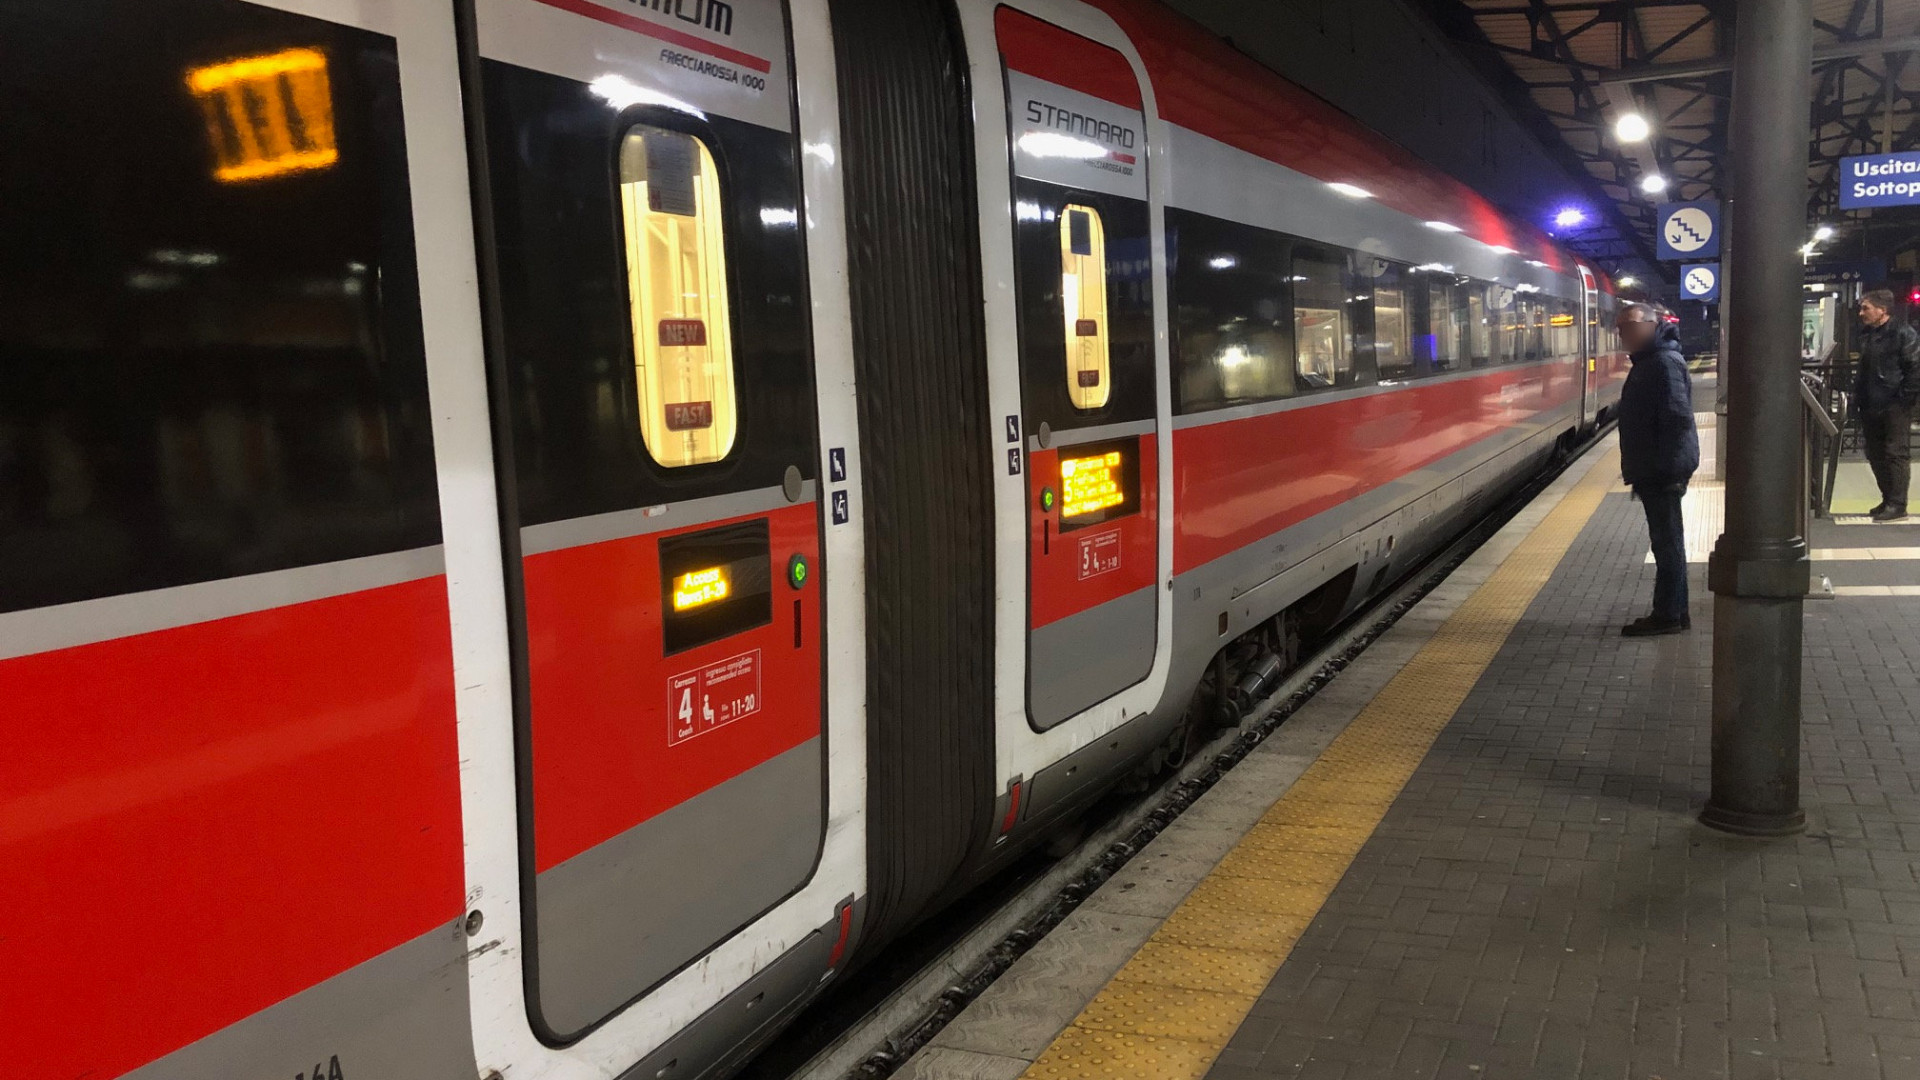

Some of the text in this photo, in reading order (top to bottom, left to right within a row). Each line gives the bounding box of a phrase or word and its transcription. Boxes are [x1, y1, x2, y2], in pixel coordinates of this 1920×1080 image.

[659, 49, 765, 92] FRECCIAROSSA 1000
[1026, 100, 1135, 149] STANDARD
[1853, 181, 1920, 198] Sottop
[665, 324, 698, 342] NEW
[674, 406, 706, 425] FAST
[1083, 546, 1090, 570] 5
[678, 687, 693, 725] 4
[732, 693, 755, 717] 11-20
